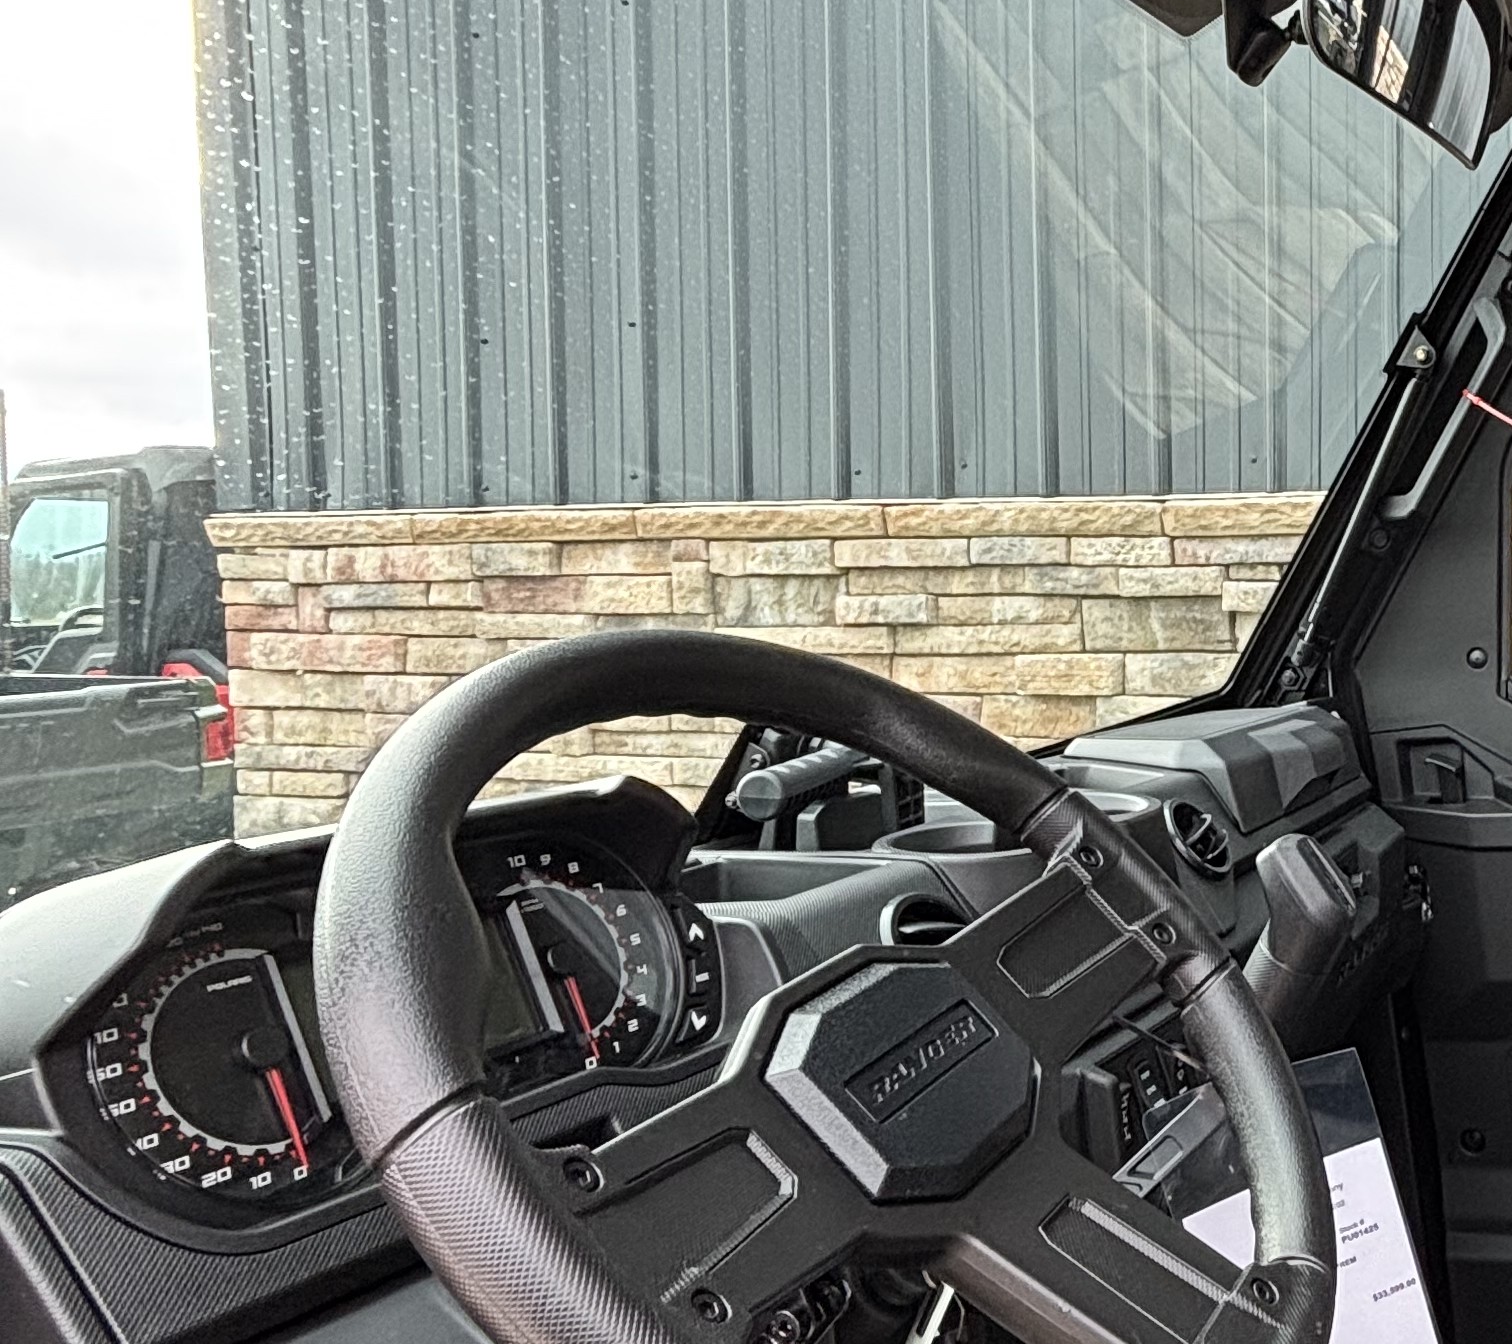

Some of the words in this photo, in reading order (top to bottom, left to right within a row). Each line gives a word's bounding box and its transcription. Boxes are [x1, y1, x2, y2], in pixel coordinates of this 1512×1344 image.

[506, 854, 526, 868] 10
[539, 854, 551, 866] 9
[567, 861, 580, 874] 8
[592, 882, 604, 893] 7
[615, 904, 627, 917] 6
[629, 932, 641, 946] 5
[636, 963, 648, 975] 4
[635, 993, 647, 1007] 3
[626, 1018, 639, 1033] 2
[612, 1041, 621, 1054] 1
[584, 1056, 598, 1070] 0
[872, 1016, 976, 1107] RANGER
[200, 1166, 232, 1189] 20
[293, 1164, 308, 1181] 0
[249, 1171, 272, 1189] 10
